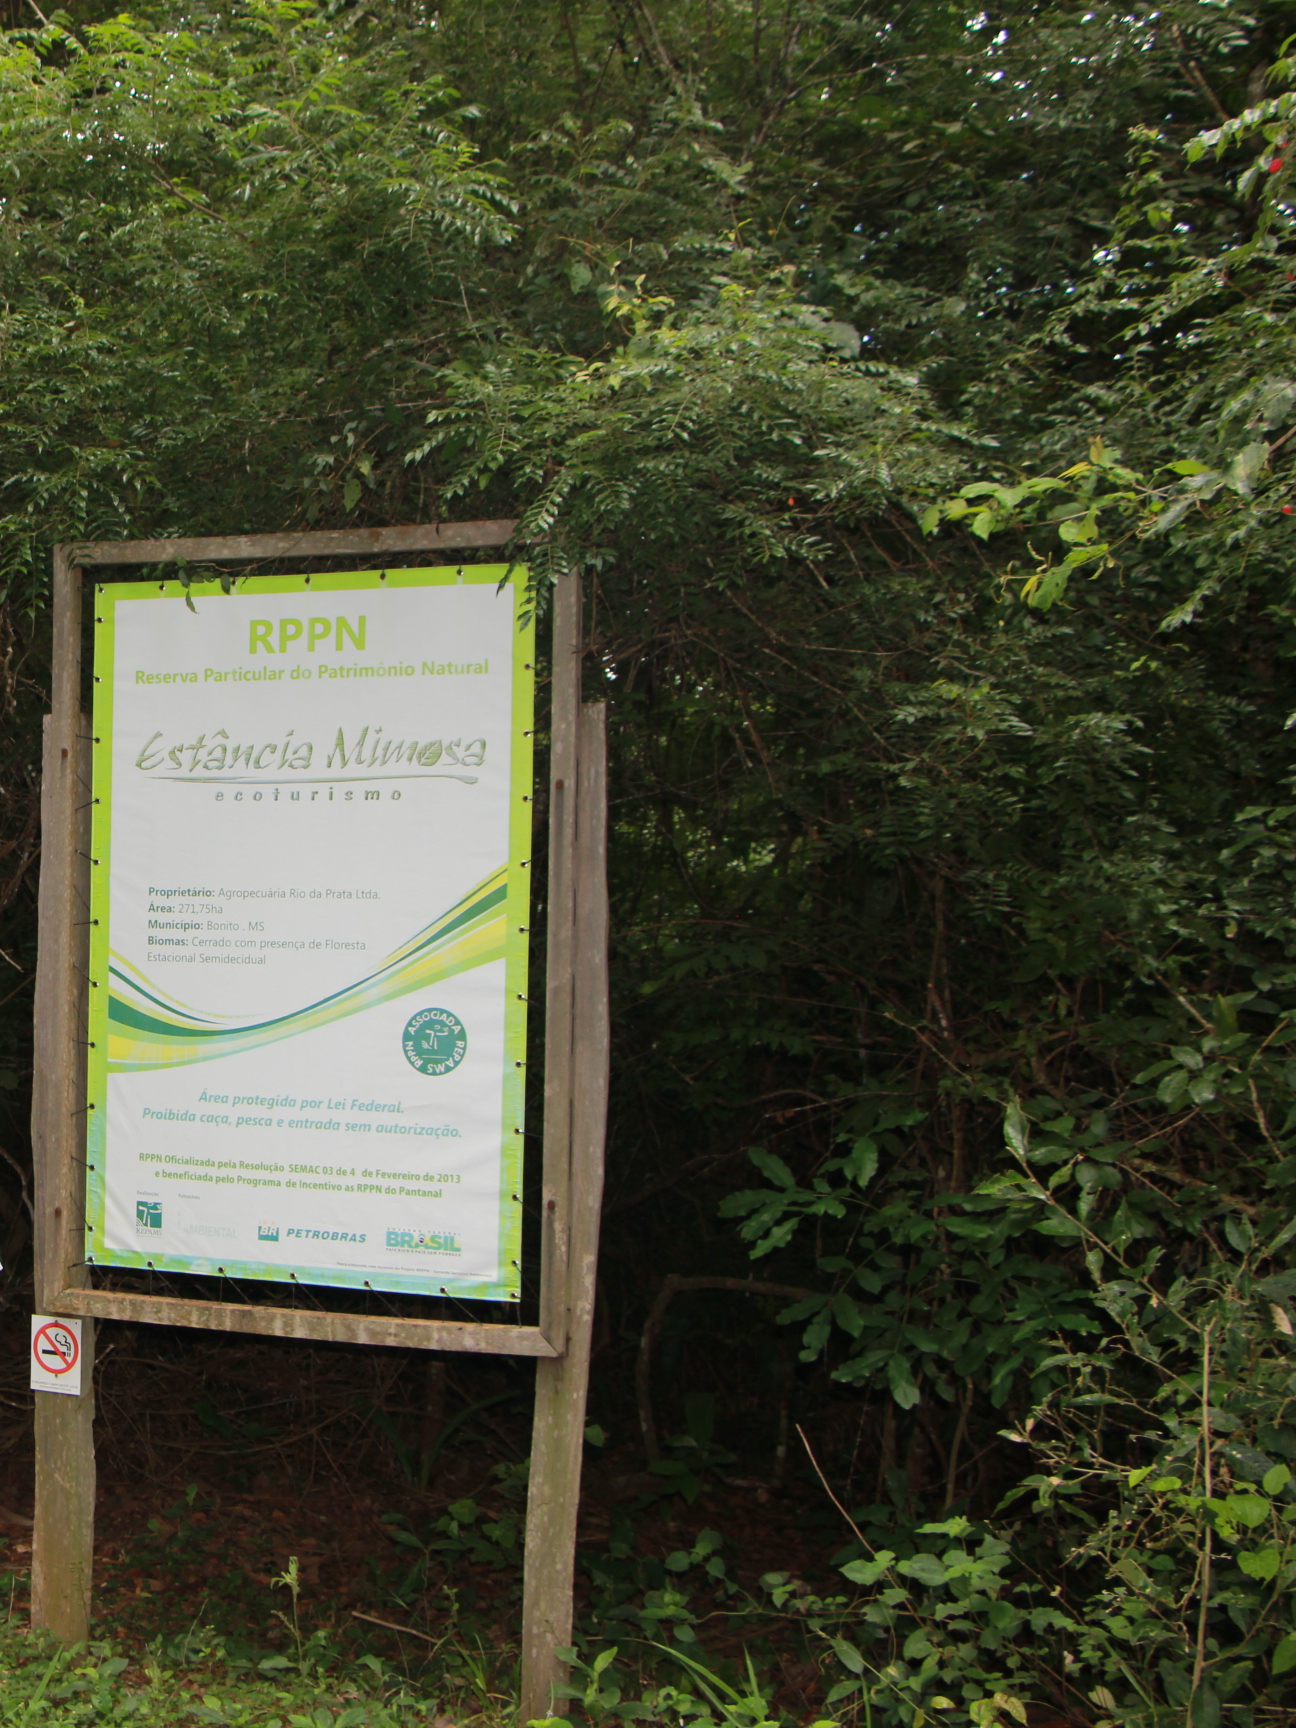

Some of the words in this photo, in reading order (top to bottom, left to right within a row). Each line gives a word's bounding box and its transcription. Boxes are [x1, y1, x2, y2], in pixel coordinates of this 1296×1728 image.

[249, 615, 366, 654] RPPN
[135, 670, 197, 684] Reserva
[204, 666, 284, 682] Particular
[290, 665, 312, 680] do
[318, 661, 414, 679] Patrimônio
[422, 659, 489, 675] Natural
[135, 728, 313, 772] Estância
[327, 726, 486, 769] Mimosa
[215, 787, 402, 801] ecoturismo
[148, 887, 215, 899] Proprietário:
[218, 888, 286, 900] Agropecuária
[290, 888, 306, 899] Rio
[309, 888, 322, 899] da
[326, 889, 352, 900] Prata
[356, 889, 381, 900] Ltda.
[148, 902, 175, 913] Área:
[178, 904, 223, 915] 271,75ha
[148, 920, 204, 932] Município:
[207, 921, 239, 931] Bonito
[249, 921, 265, 931] MS
[148, 936, 189, 947] Biomas:
[191, 937, 232, 948] Cerrado
[234, 940, 256, 948] com
[259, 940, 305, 951] presença
[308, 939, 322, 950] de
[325, 940, 366, 950] Floresta
[147, 952, 195, 963] Estacional
[199, 953, 266, 965] Semidecidual
[408, 1010, 462, 1035] ASSOCIADA
[404, 1041, 424, 1068] RPPN
[427, 1040, 466, 1074] REPAMS
[198, 1087, 229, 1105] Área
[232, 1093, 297, 1110] protegida
[300, 1098, 323, 1111] por
[327, 1097, 346, 1110] Lei
[350, 1099, 404, 1114] Federal.
[142, 1107, 196, 1122] Proibida
[199, 1112, 232, 1127] caça,
[236, 1115, 273, 1128] pesca
[277, 1118, 285, 1128] e
[288, 1117, 341, 1131] entrada
[344, 1122, 371, 1133] sem
[375, 1121, 463, 1140] autorização.
[139, 1152, 162, 1164] RPPN
[164, 1153, 216, 1168] Oficializada
[217, 1158, 237, 1171] pela
[239, 1159, 285, 1174] Resolução
[288, 1163, 320, 1176] SEMAC
[322, 1166, 334, 1176] 03
[335, 1166, 348, 1177] de
[349, 1167, 356, 1177] 4
[361, 1168, 373, 1179] de
[375, 1169, 421, 1182] Fevereiro
[422, 1171, 435, 1183] de
[436, 1173, 461, 1184] 2013
[154, 1170, 160, 1178] e
[162, 1169, 214, 1183] beneficiada
[215, 1173, 235, 1186] pelo
[237, 1175, 282, 1190] Programa
[285, 1177, 297, 1189] de
[299, 1179, 342, 1192] Incentivo
[344, 1183, 355, 1192] as
[356, 1182, 383, 1194] RPPN
[384, 1184, 397, 1195] do
[399, 1185, 443, 1198] Pantanal
[136, 1228, 162, 1236] REPAMS
[260, 1226, 277, 1237] BR
[286, 1228, 366, 1243] PETROBRAS
[386, 1231, 461, 1252] BRASIL
